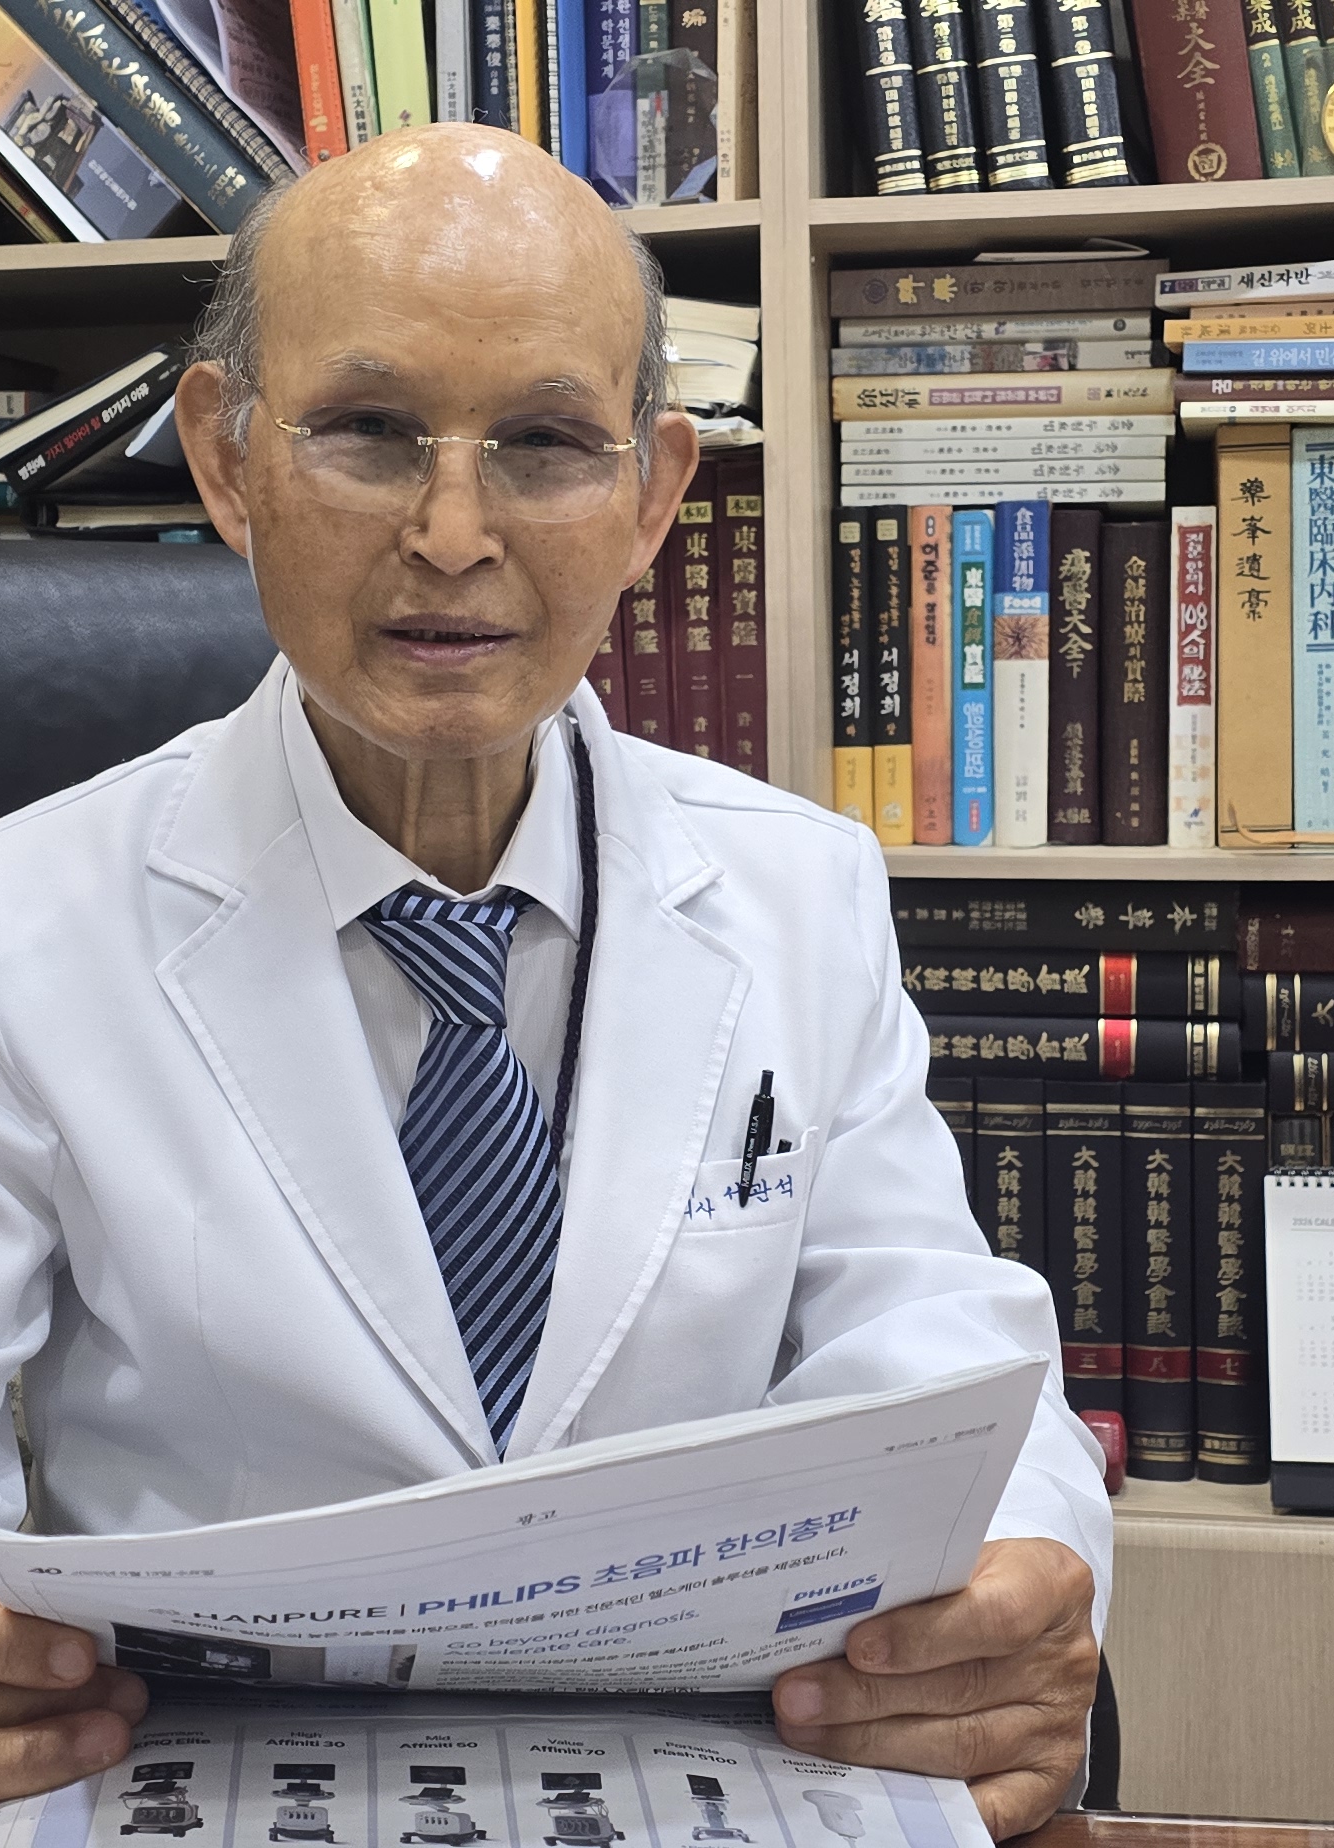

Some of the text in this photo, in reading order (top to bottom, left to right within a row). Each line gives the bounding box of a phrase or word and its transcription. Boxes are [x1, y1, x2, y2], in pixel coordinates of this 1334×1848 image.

[1236, 266, 1311, 289] 새신자반
[1251, 347, 1266, 365] 길
[1268, 347, 1312, 366] 위에서
[1012, 506, 1036, 592] 食品添加物
[684, 531, 713, 652] 東醫寶鑑
[731, 525, 759, 647] 東醫寶鑑
[1003, 595, 1042, 610] Food
[840, 648, 861, 719] 서정희
[878, 646, 901, 718] 서정희
[192, 1505, 863, 1626] HANPURE PHILIPS 초음파 한의총판
[793, 1573, 879, 1602] PHILIPS
[547, 1604, 581, 1620] 위한
[583, 1592, 645, 1617] 전문적인
[445, 1608, 701, 1650] Go beyond diagnosis.
[577, 1636, 632, 1650] care.
[290, 1730, 323, 1739] High
[425, 1734, 452, 1742] Mid
[547, 1736, 585, 1748] Value
[265, 1738, 319, 1749] Affiniti
[399, 1741, 454, 1750] Affiniti
[529, 1744, 606, 1757] Affiniti 70
[665, 1741, 720, 1756] Portable
[652, 1748, 702, 1763] Flash
[794, 1767, 848, 1779] Lumify
